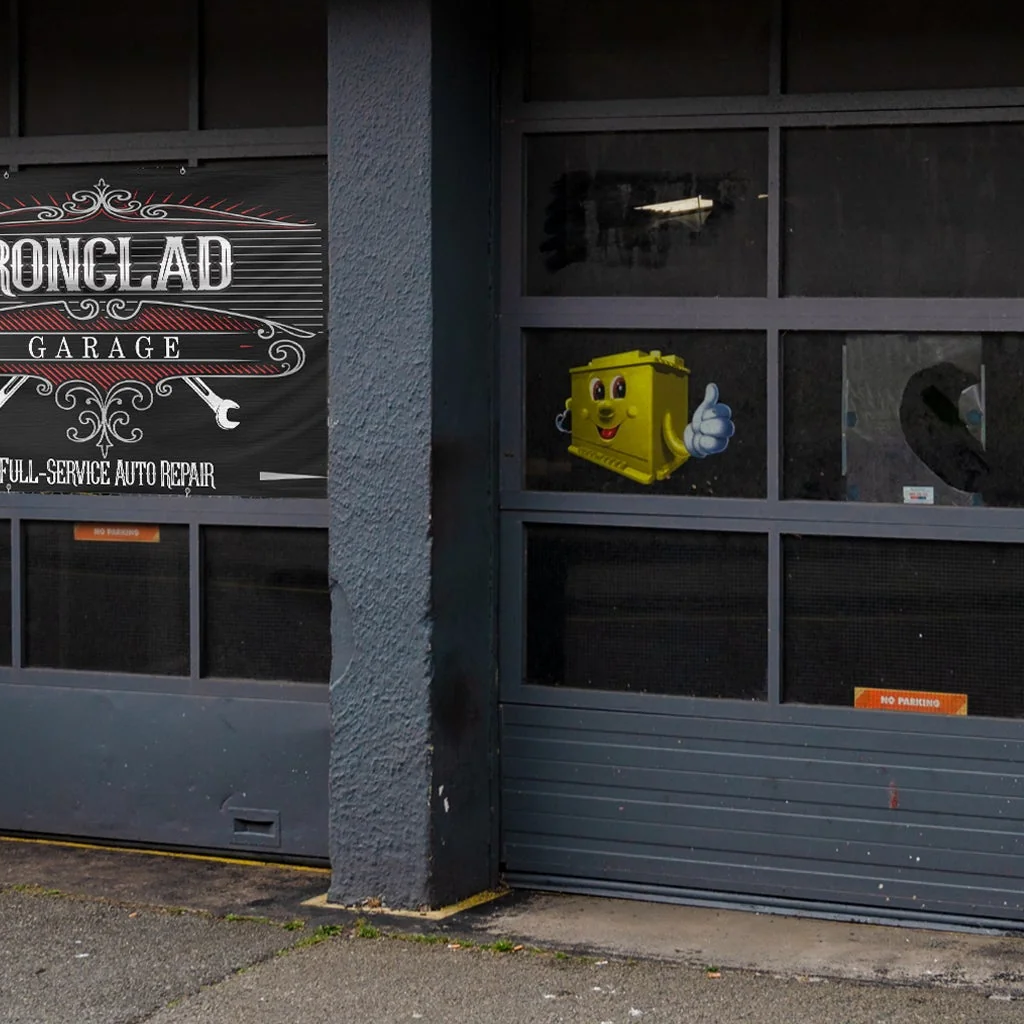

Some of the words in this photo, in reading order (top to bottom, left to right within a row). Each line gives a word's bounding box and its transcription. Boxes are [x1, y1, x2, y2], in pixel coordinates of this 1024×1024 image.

[28, 336, 181, 360] GARAGE
[0, 457, 110, 487] FULL-SERVICE
[114, 459, 156, 486] AUTO
[160, 460, 216, 489] REPAIR
[94, 528, 105, 536] NO
[107, 528, 140, 537] PARKING
[880, 696, 895, 704] NO
[898, 696, 940, 708] PARKING
